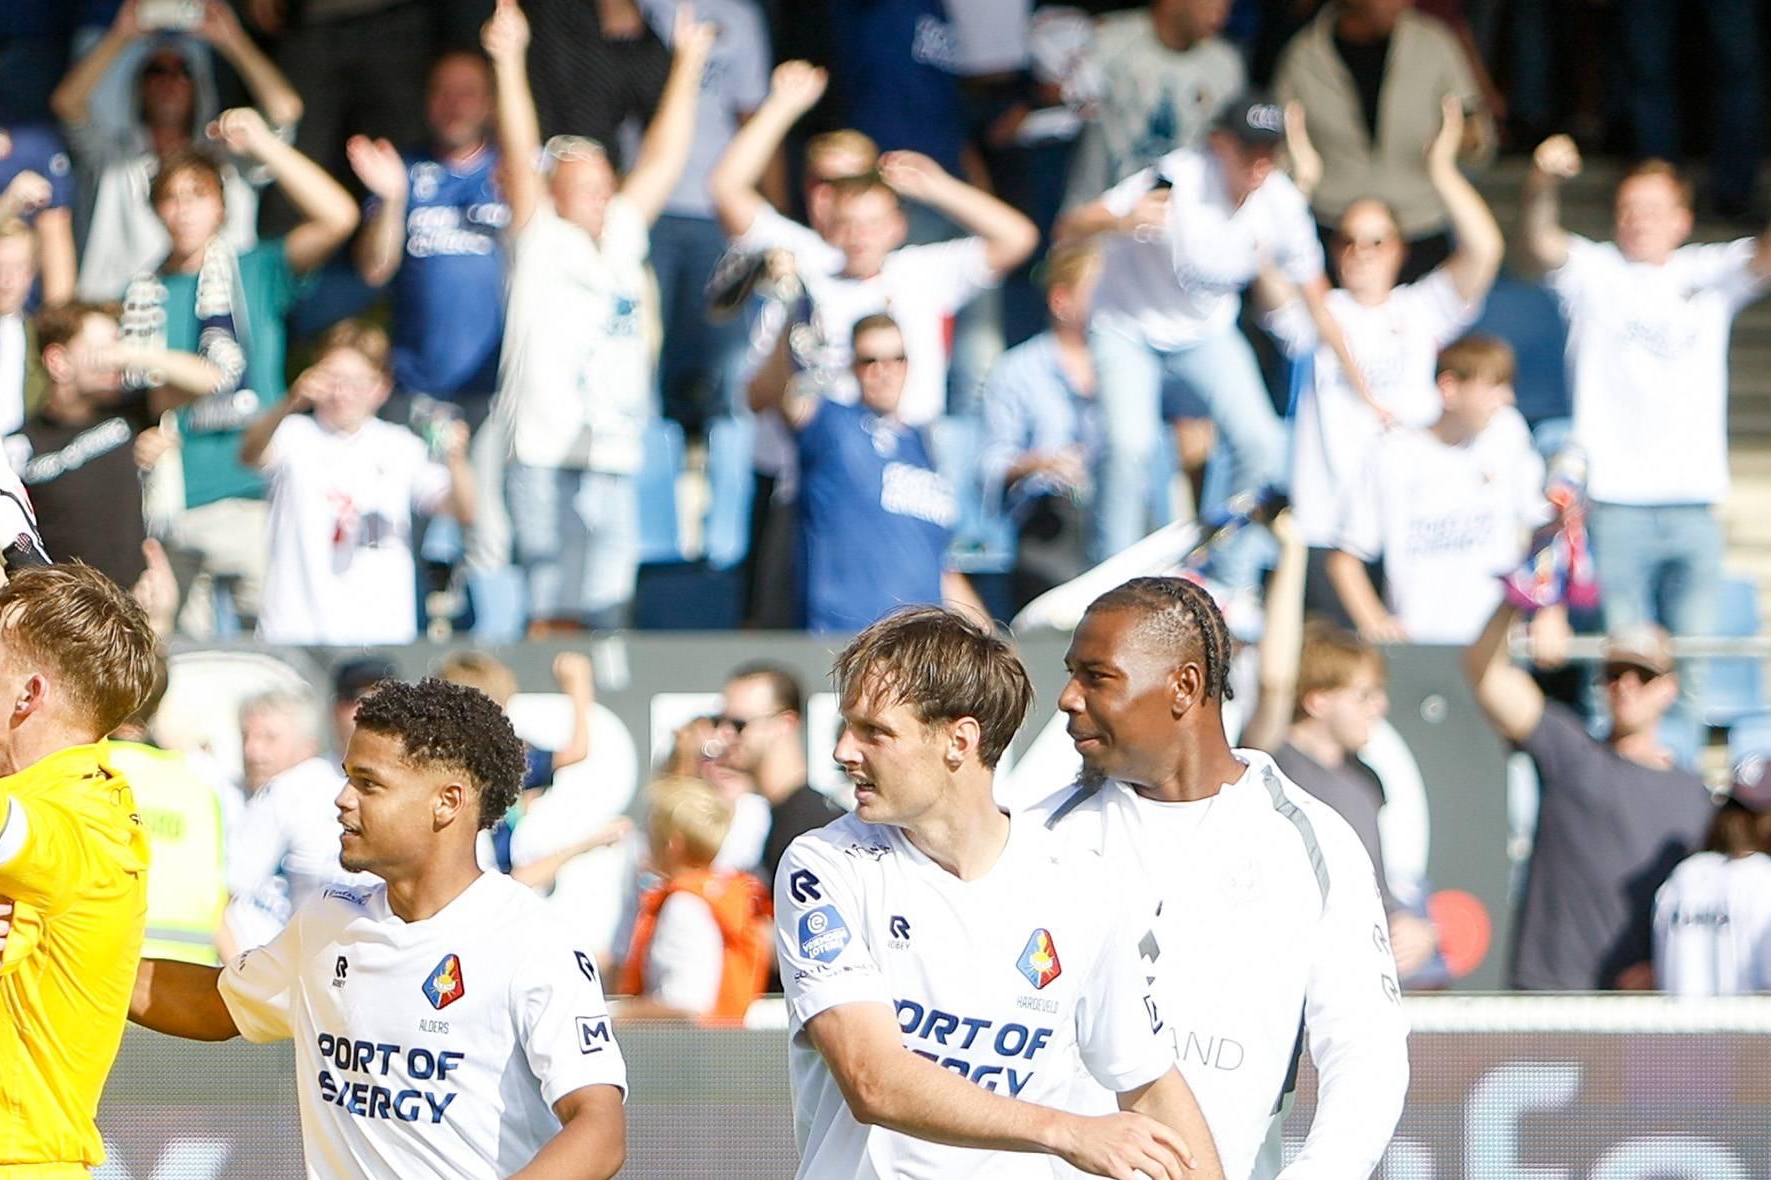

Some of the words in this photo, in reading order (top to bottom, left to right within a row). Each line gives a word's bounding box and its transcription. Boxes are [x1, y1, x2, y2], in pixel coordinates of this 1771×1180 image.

[419, 1019, 449, 1035] ALDERS
[893, 999, 992, 1050] ORT
[994, 1023, 1053, 1060] OF
[318, 1033, 400, 1076] PORT
[407, 1048, 465, 1081] OF
